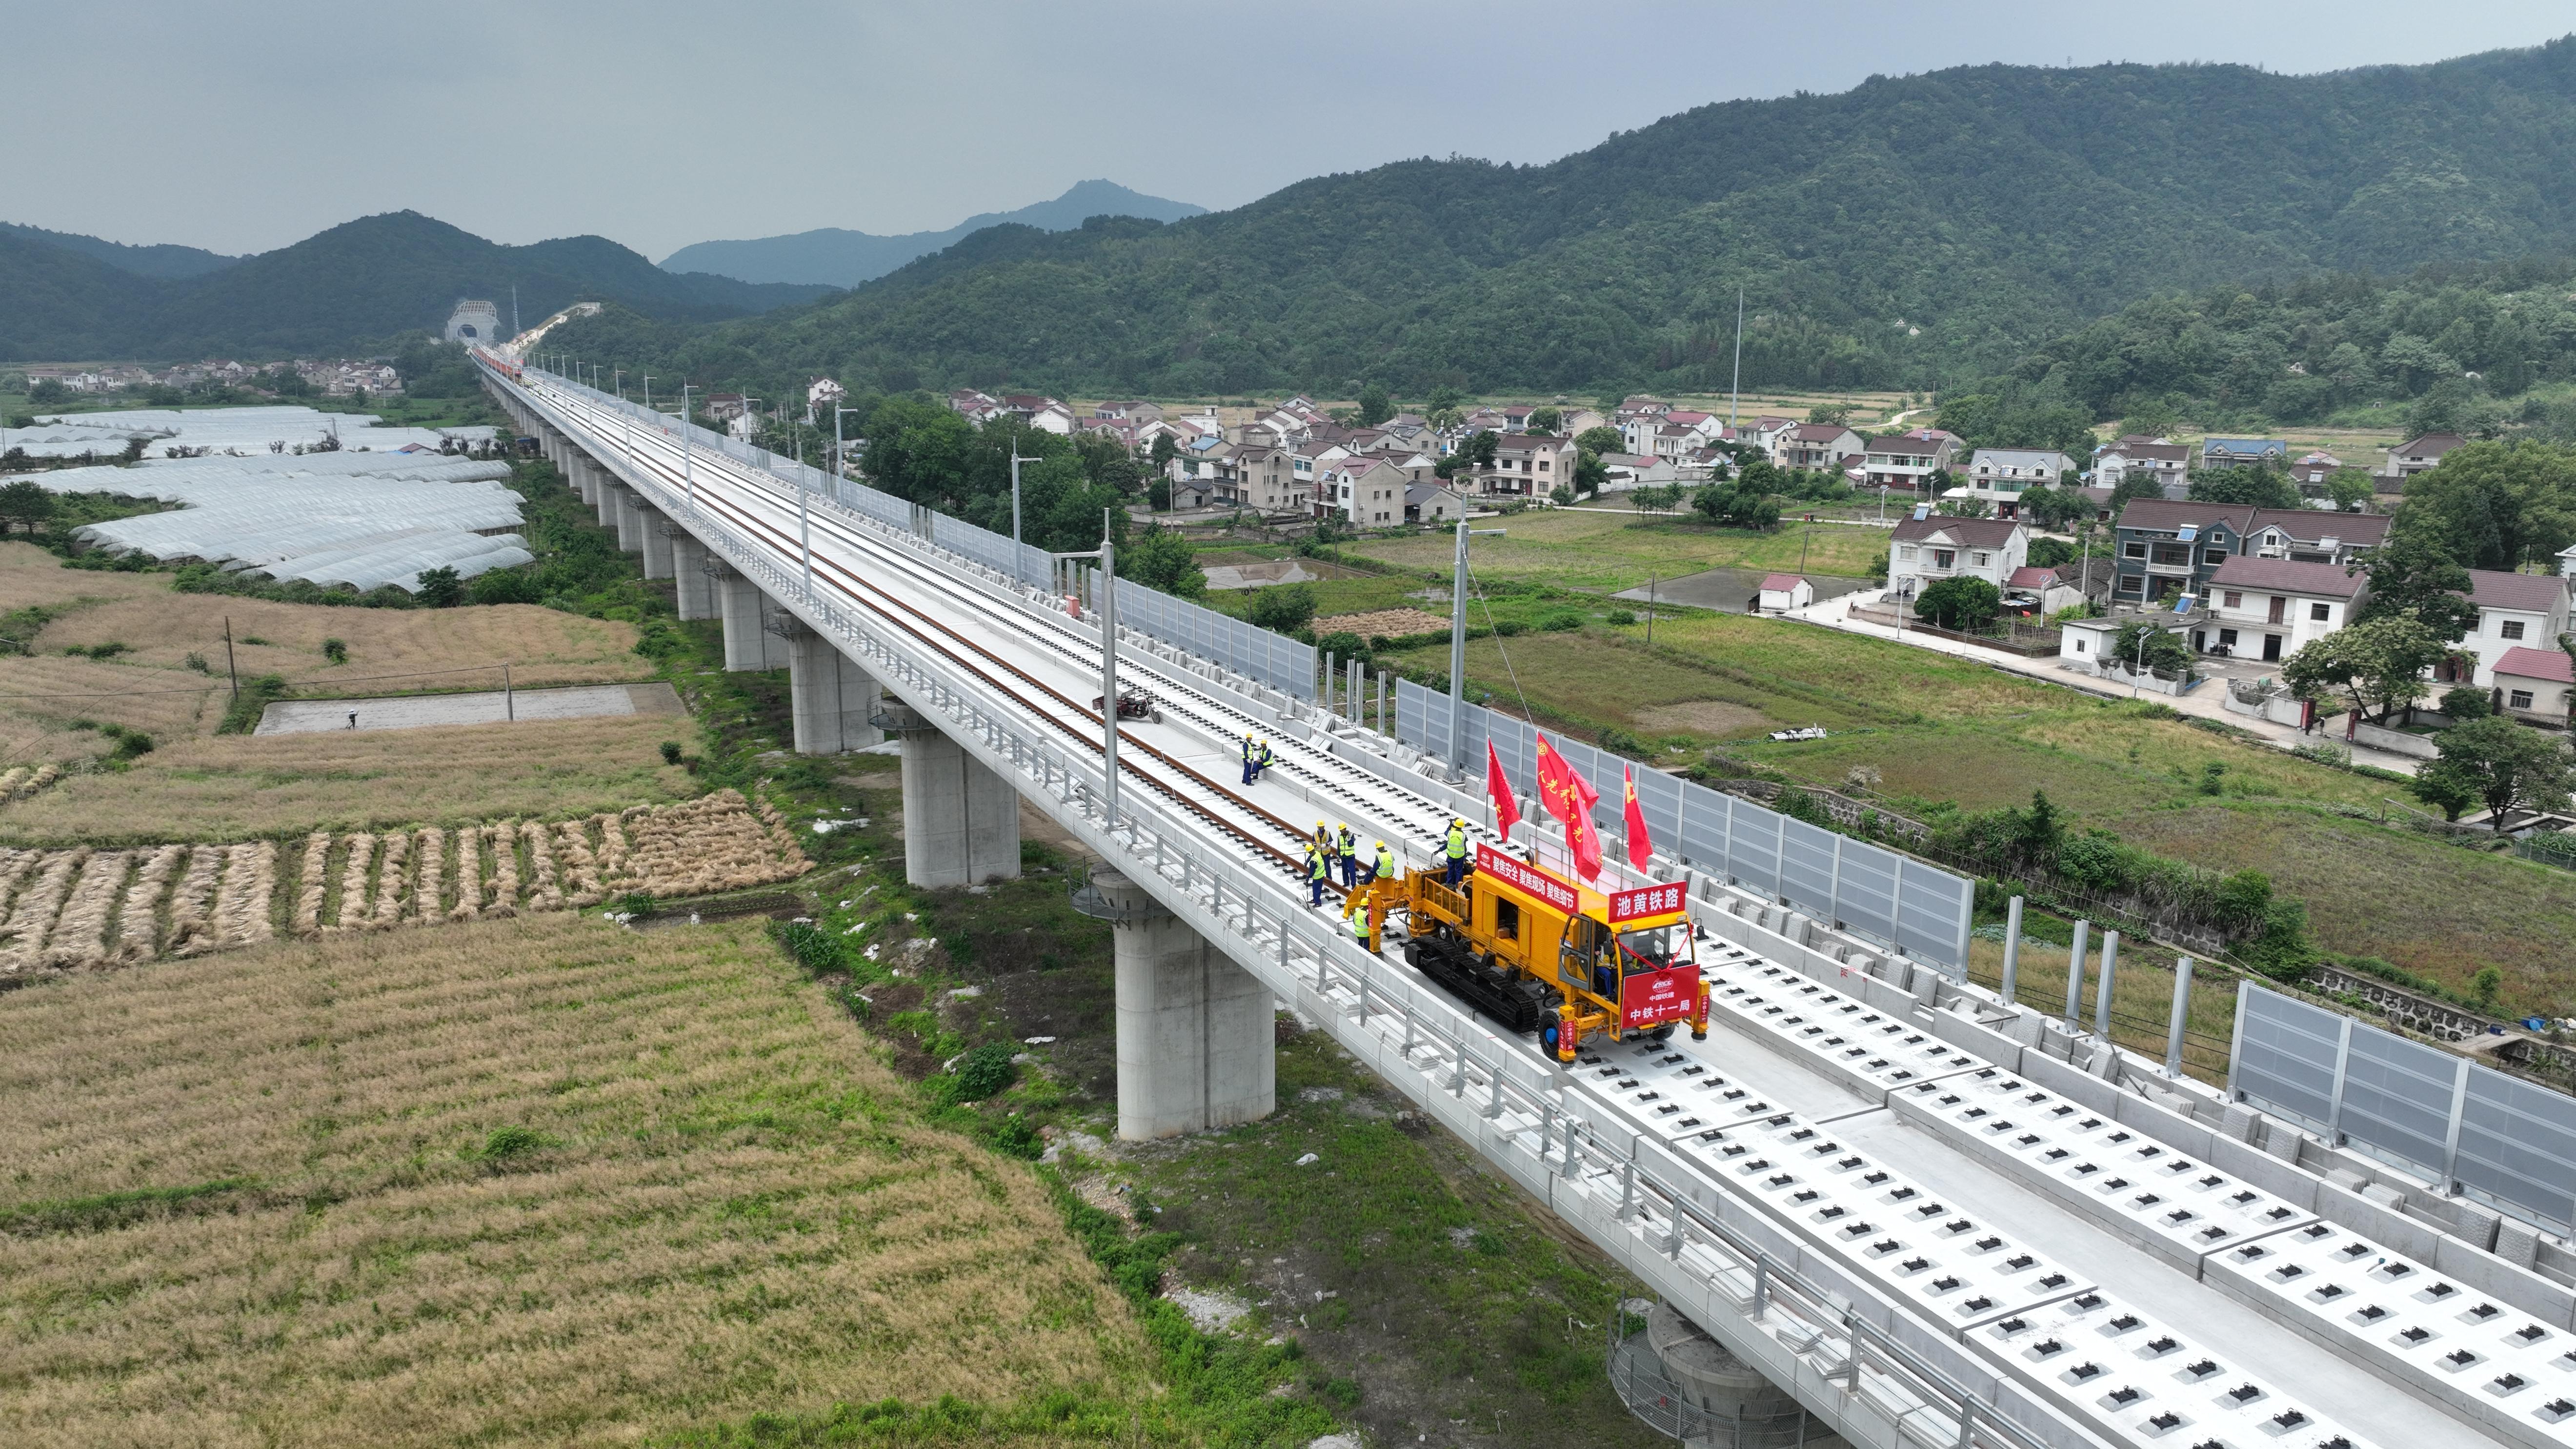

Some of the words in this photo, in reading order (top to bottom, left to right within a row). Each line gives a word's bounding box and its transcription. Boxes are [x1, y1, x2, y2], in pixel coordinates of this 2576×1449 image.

[1493, 856, 1518, 882] 聚焦安全
[1519, 868, 1546, 895] 聚焦现场
[1547, 882, 1574, 909] 聚焦细节
[1617, 887, 1679, 917] 池黄铁路
[1630, 999, 1690, 1021] 中铁十一局
